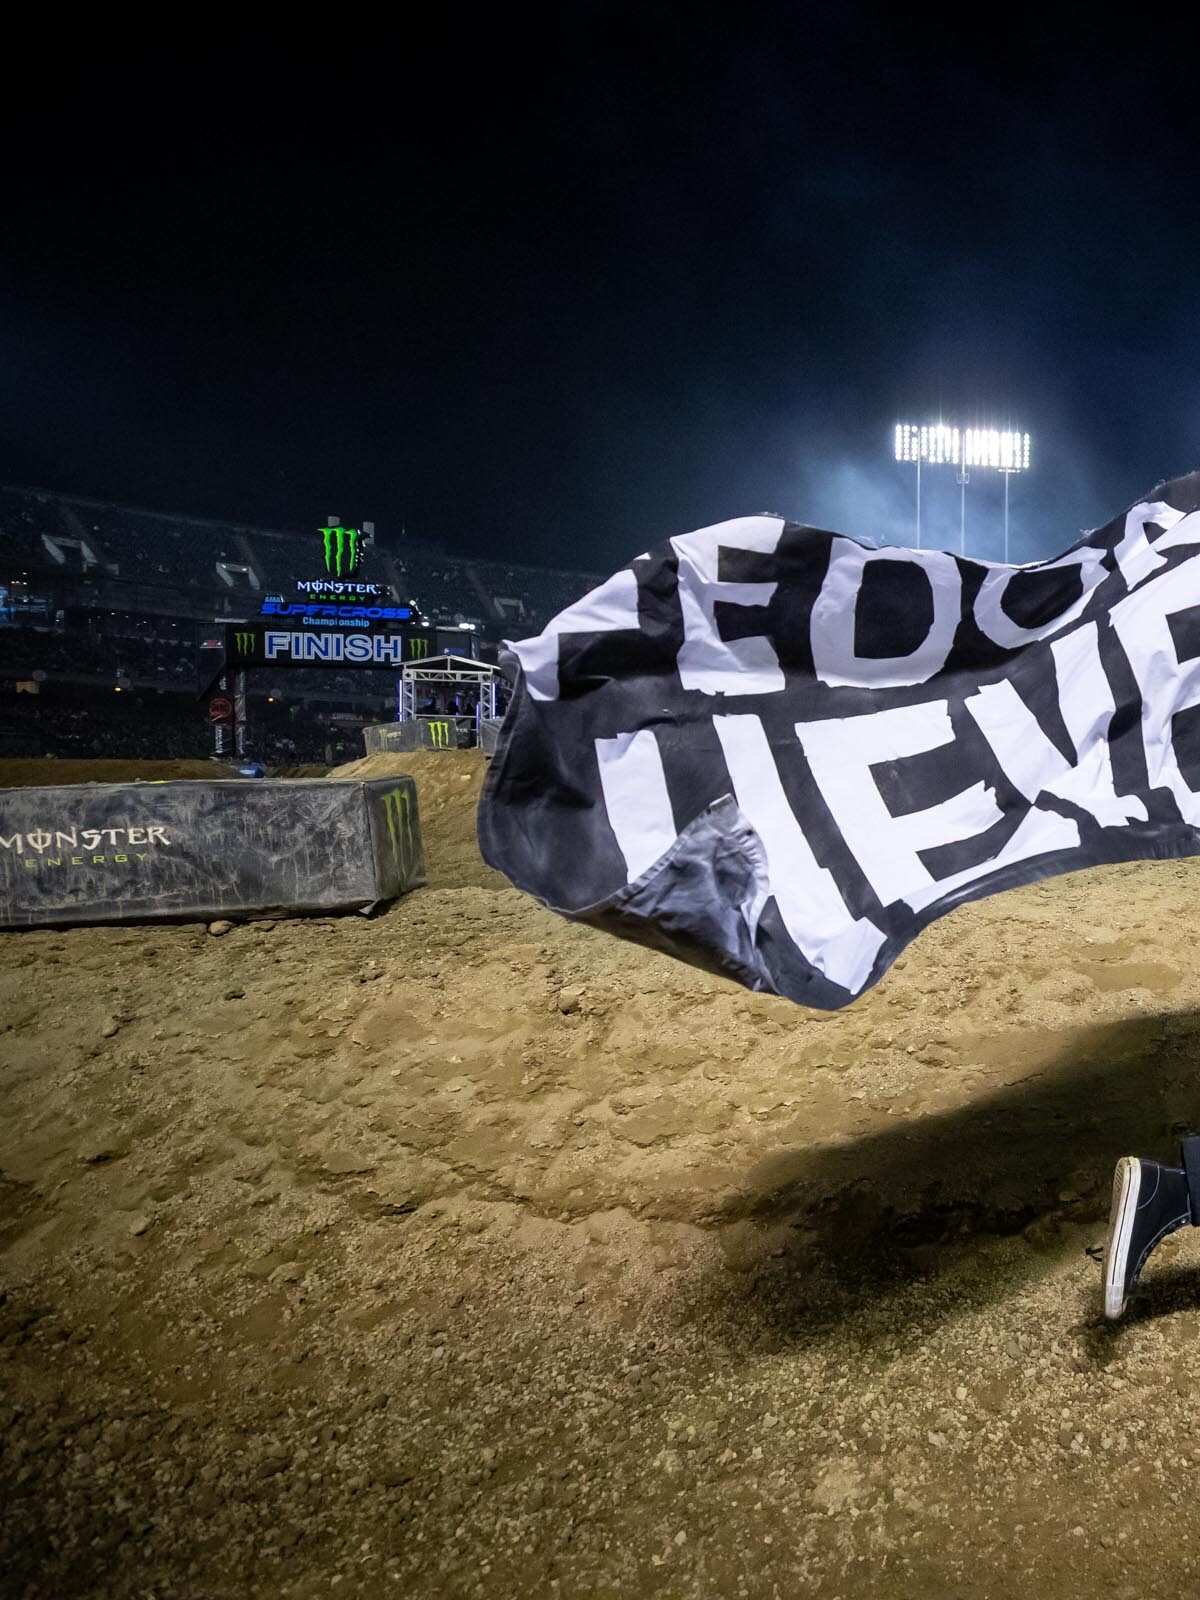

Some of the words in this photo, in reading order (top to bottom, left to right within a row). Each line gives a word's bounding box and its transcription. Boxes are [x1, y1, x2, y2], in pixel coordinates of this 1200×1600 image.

[302, 617, 370, 627] Championship
[265, 631, 402, 662] FINISH
[25, 853, 150, 868] ENERGY
